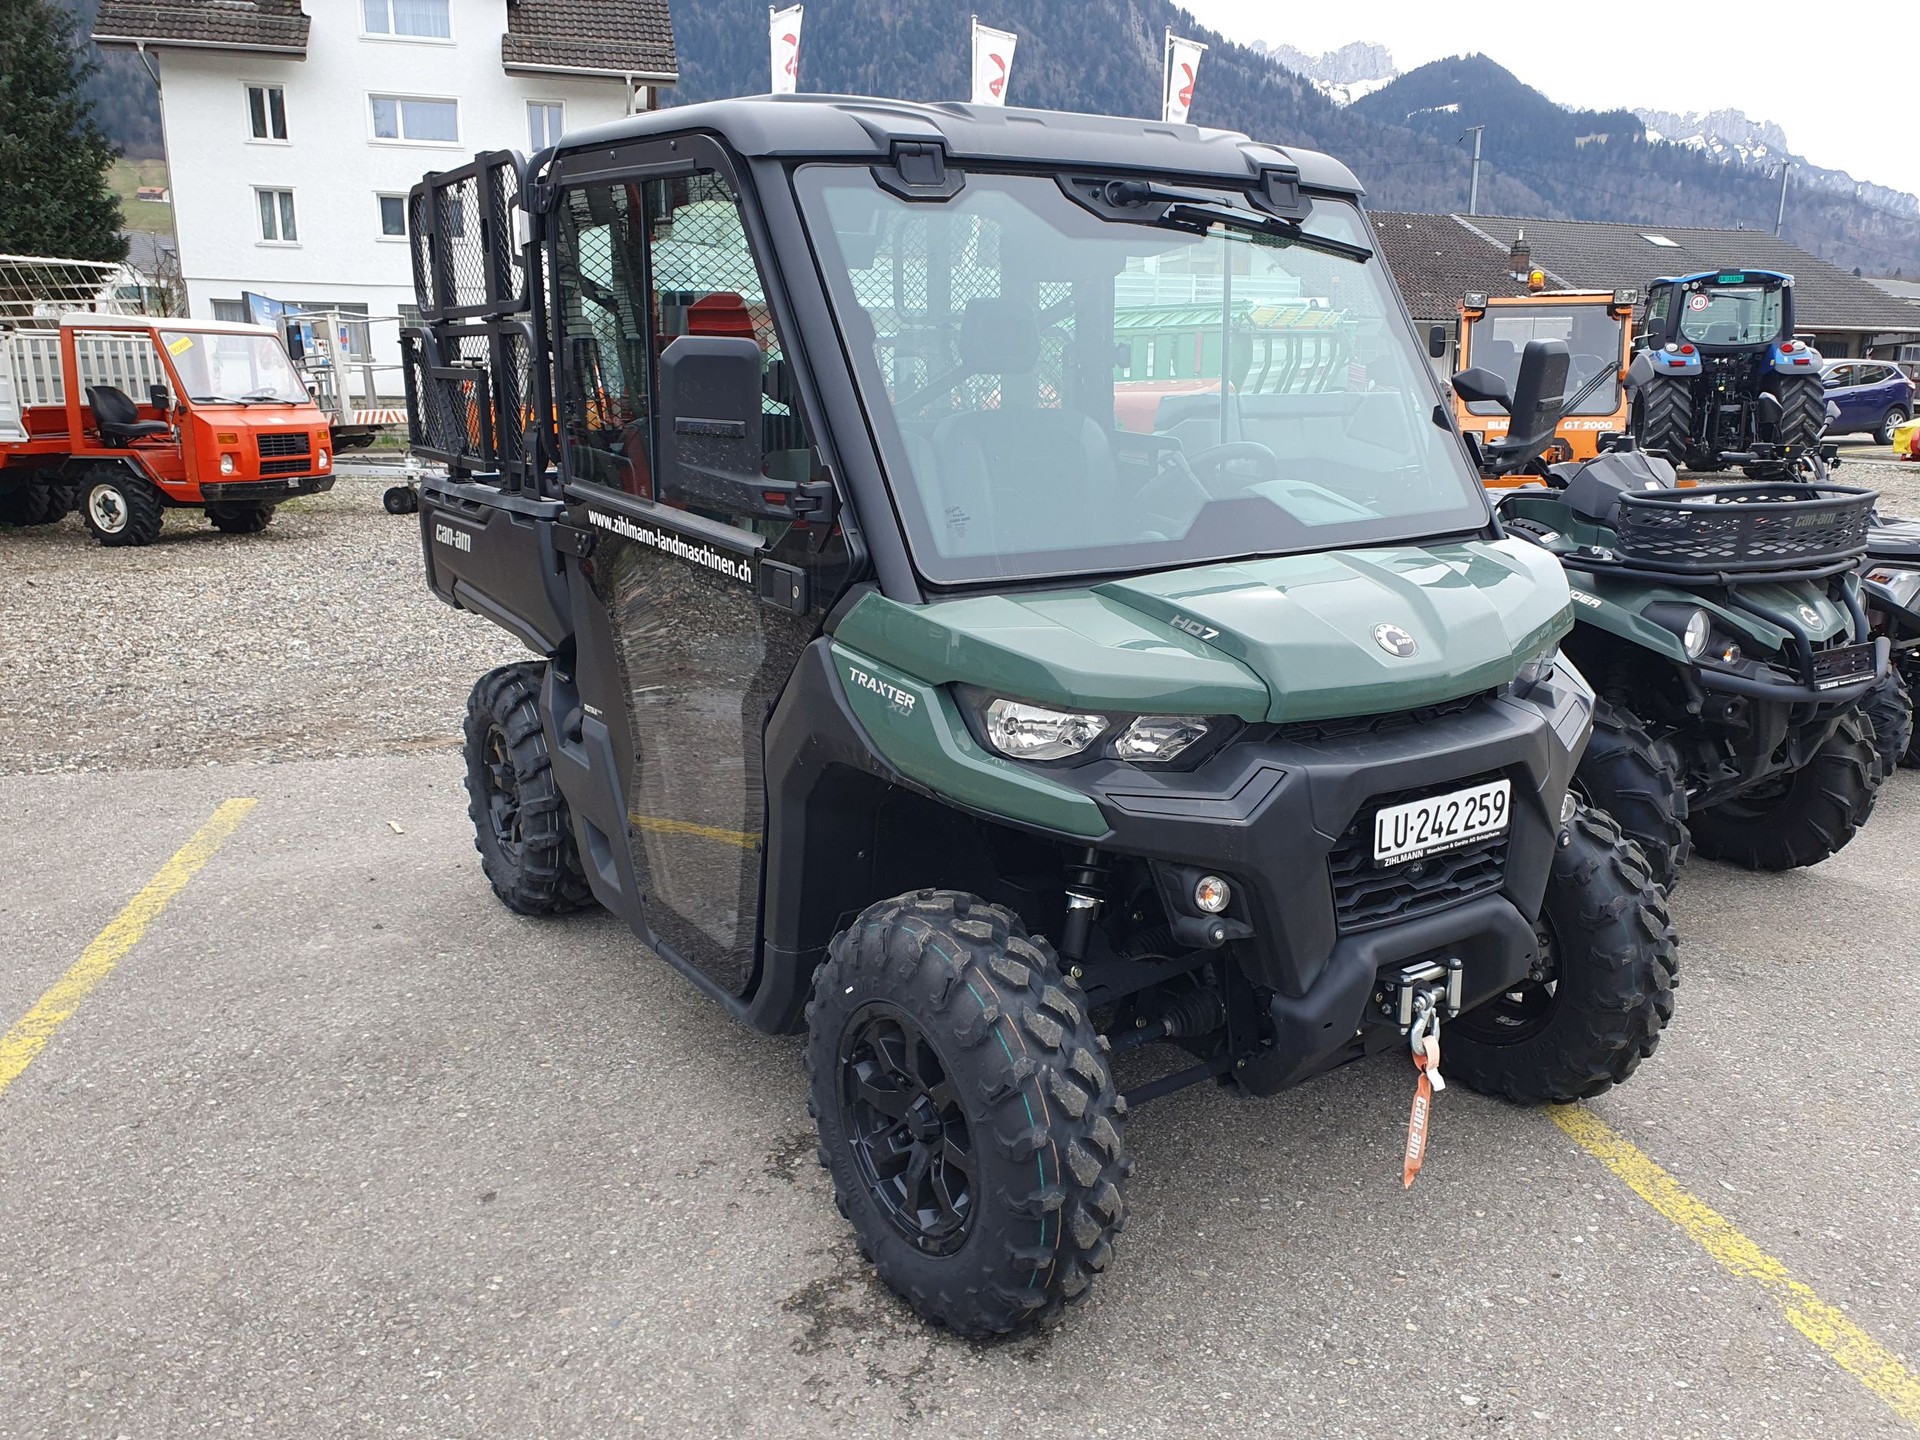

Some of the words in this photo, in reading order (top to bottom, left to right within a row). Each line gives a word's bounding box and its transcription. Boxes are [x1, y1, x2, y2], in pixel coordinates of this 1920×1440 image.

[1563, 421, 1581, 430] GT
[1583, 421, 1613, 429] 2000
[1794, 513, 1836, 528] can-am
[435, 523, 472, 553] can-am
[588, 509, 752, 583] www.zihlmann-landmaschinen.ch
[1171, 614, 1220, 641] HD7
[1395, 637, 1412, 646] BRP
[849, 666, 916, 709] TRAXTER
[1384, 849, 1424, 867] ZIHLMANN
[1407, 1096, 1427, 1160] can-am
